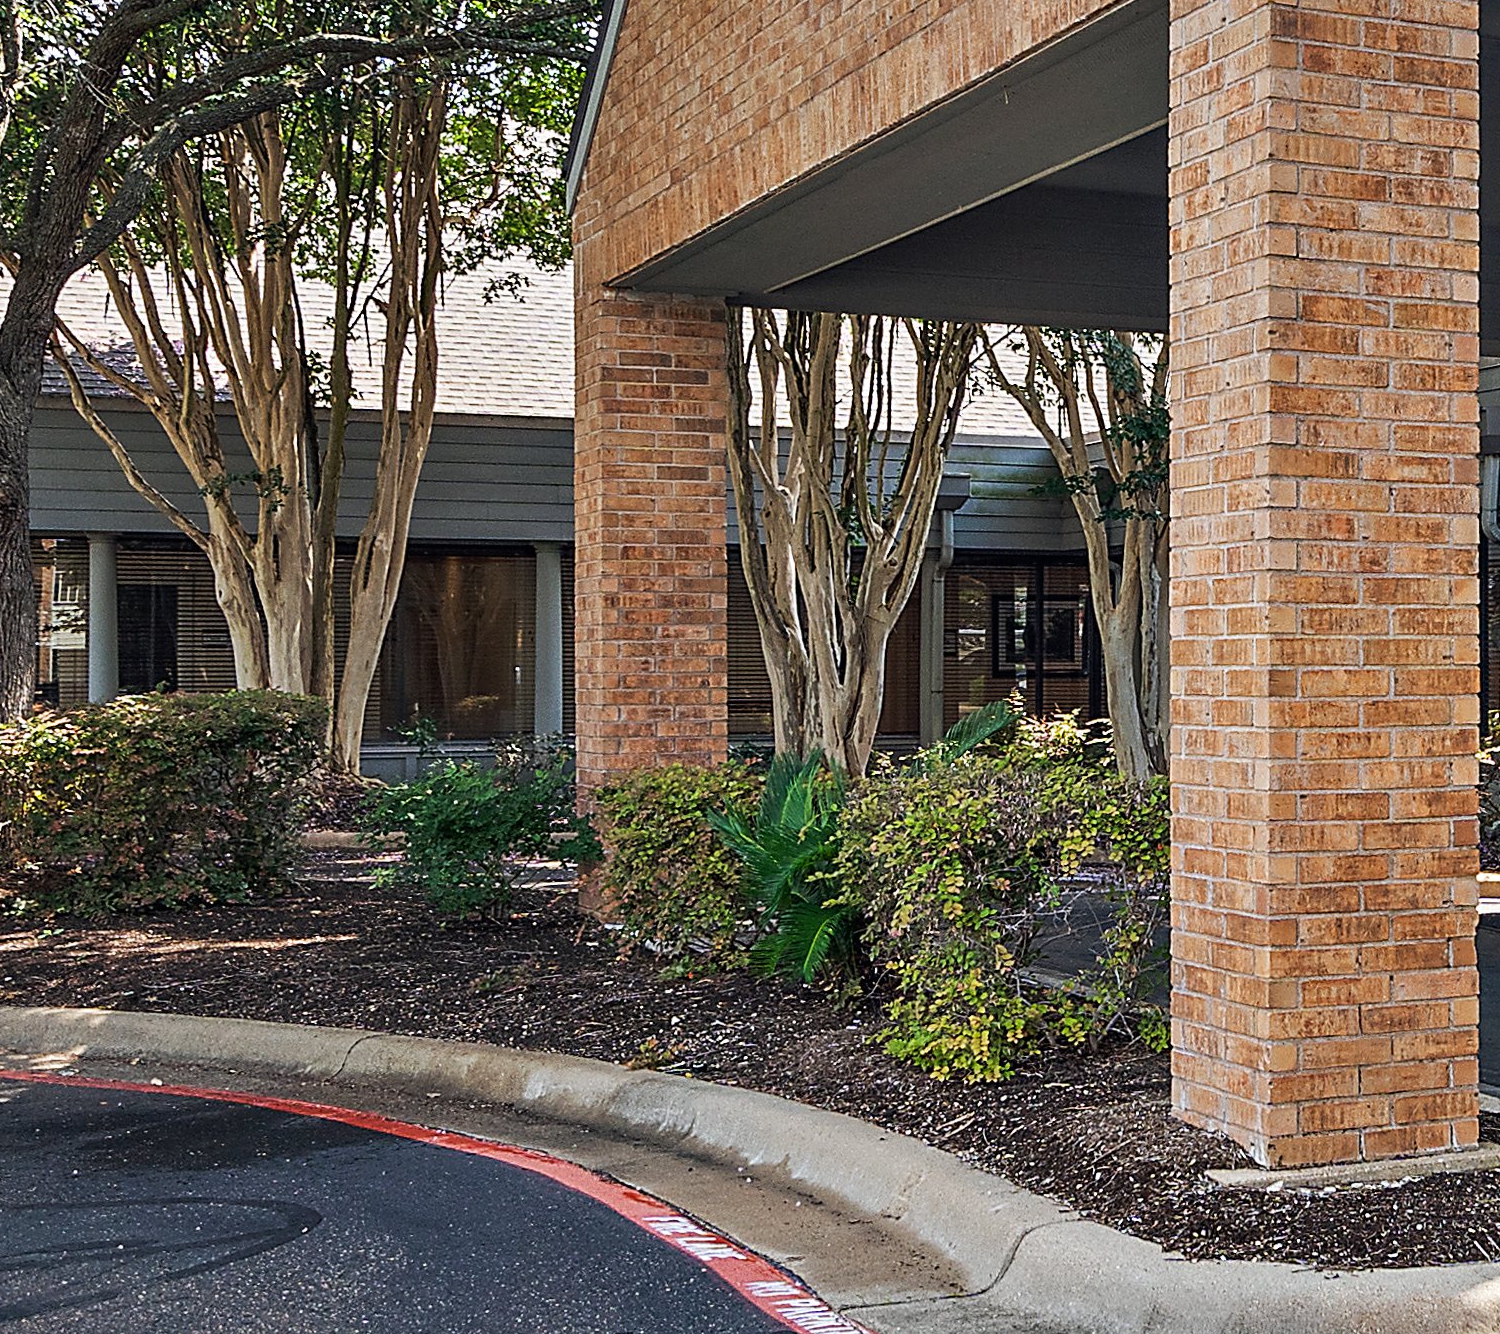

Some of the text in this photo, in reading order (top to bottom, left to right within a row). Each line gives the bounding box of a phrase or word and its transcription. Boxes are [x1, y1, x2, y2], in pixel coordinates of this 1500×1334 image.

[642, 1216, 747, 1261] FIRE LANE
[745, 1280, 802, 1298] NO
